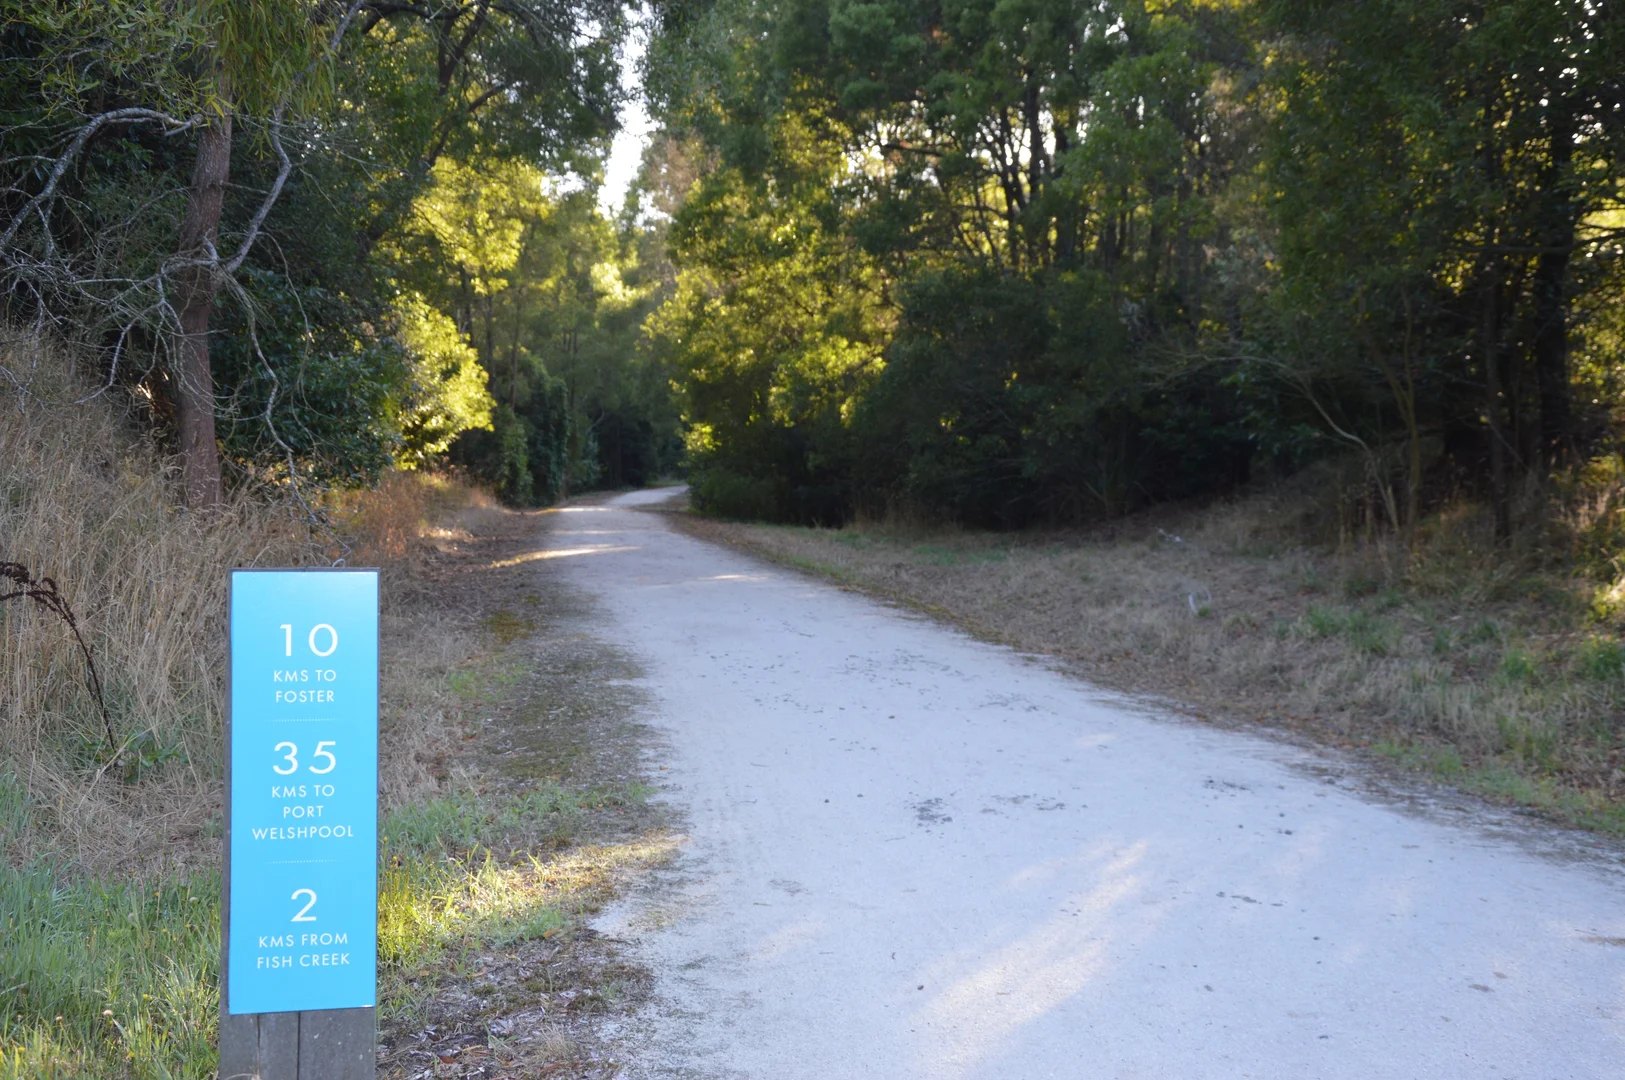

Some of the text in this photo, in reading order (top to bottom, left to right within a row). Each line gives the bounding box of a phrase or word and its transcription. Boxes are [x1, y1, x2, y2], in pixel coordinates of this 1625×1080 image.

[279, 622, 339, 658] 10
[273, 669, 337, 683] KMS TO
[275, 689, 335, 704] FOSTER
[272, 740, 337, 776] 35
[271, 784, 335, 798] KMS TO
[283, 805, 324, 819] PORT
[251, 824, 354, 840] WELSHPOOL
[290, 887, 318, 923] 2
[258, 932, 348, 948] KMS FROM
[257, 952, 350, 969] FISH CREEK
